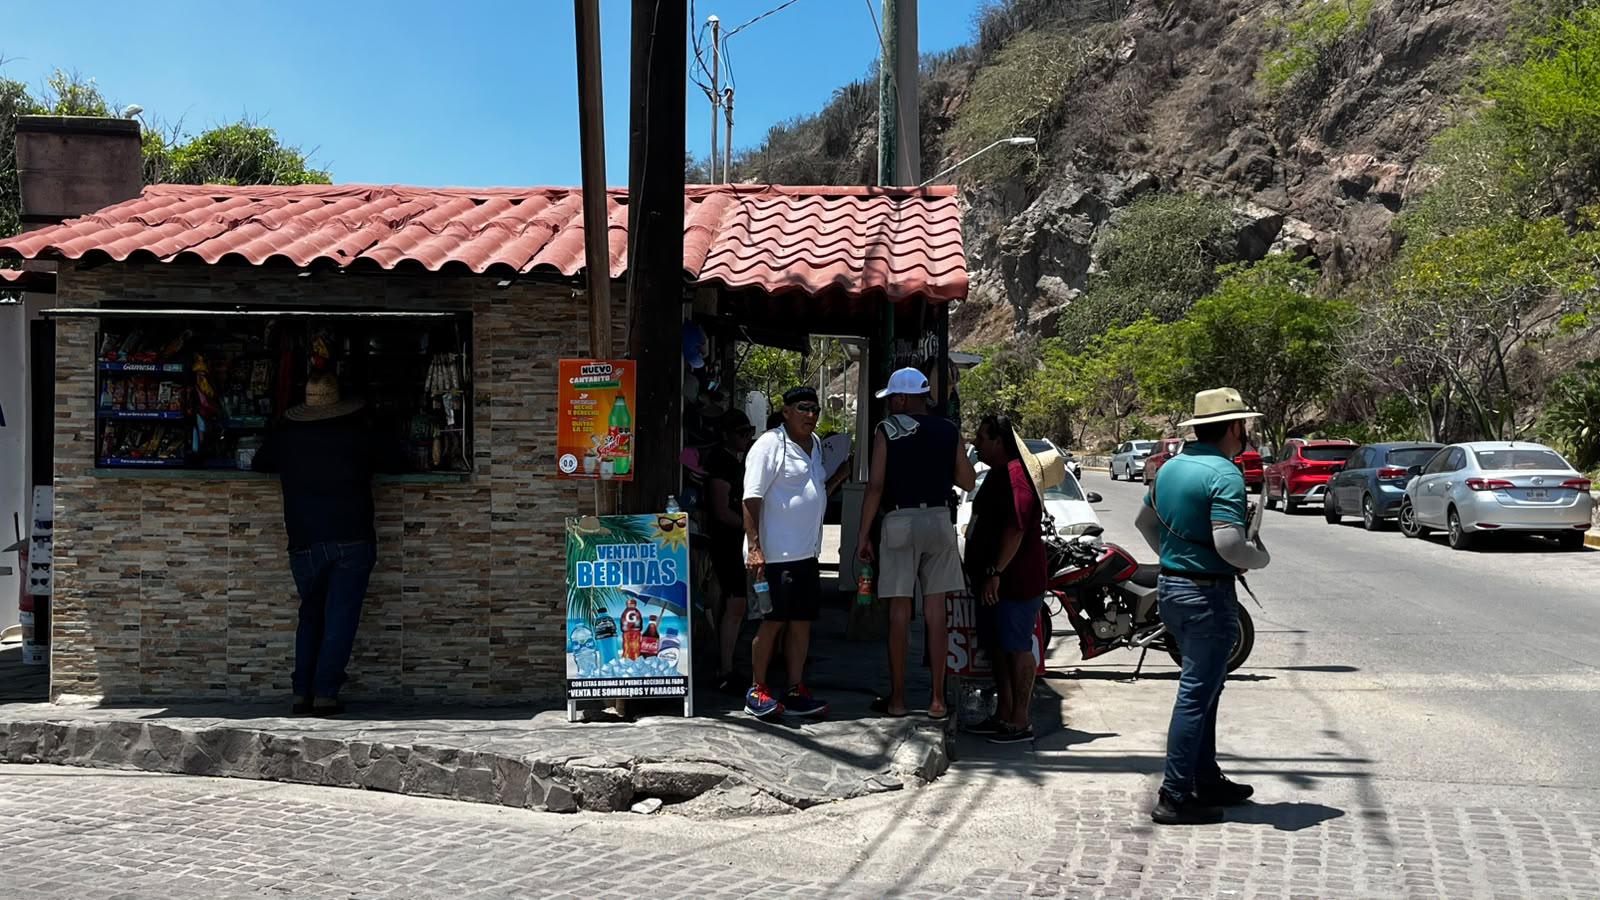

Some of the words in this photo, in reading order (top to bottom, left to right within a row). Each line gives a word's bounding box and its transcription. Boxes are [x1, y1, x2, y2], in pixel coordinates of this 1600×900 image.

[582, 365, 611, 374] NUEVO
[597, 544, 638, 560] VENTA
[640, 544, 656, 559] DE
[577, 559, 676, 587] BEBIDAS
[592, 688, 601, 697] DE
[602, 687, 643, 697] SOMBREROS
[644, 687, 650, 696] Y
